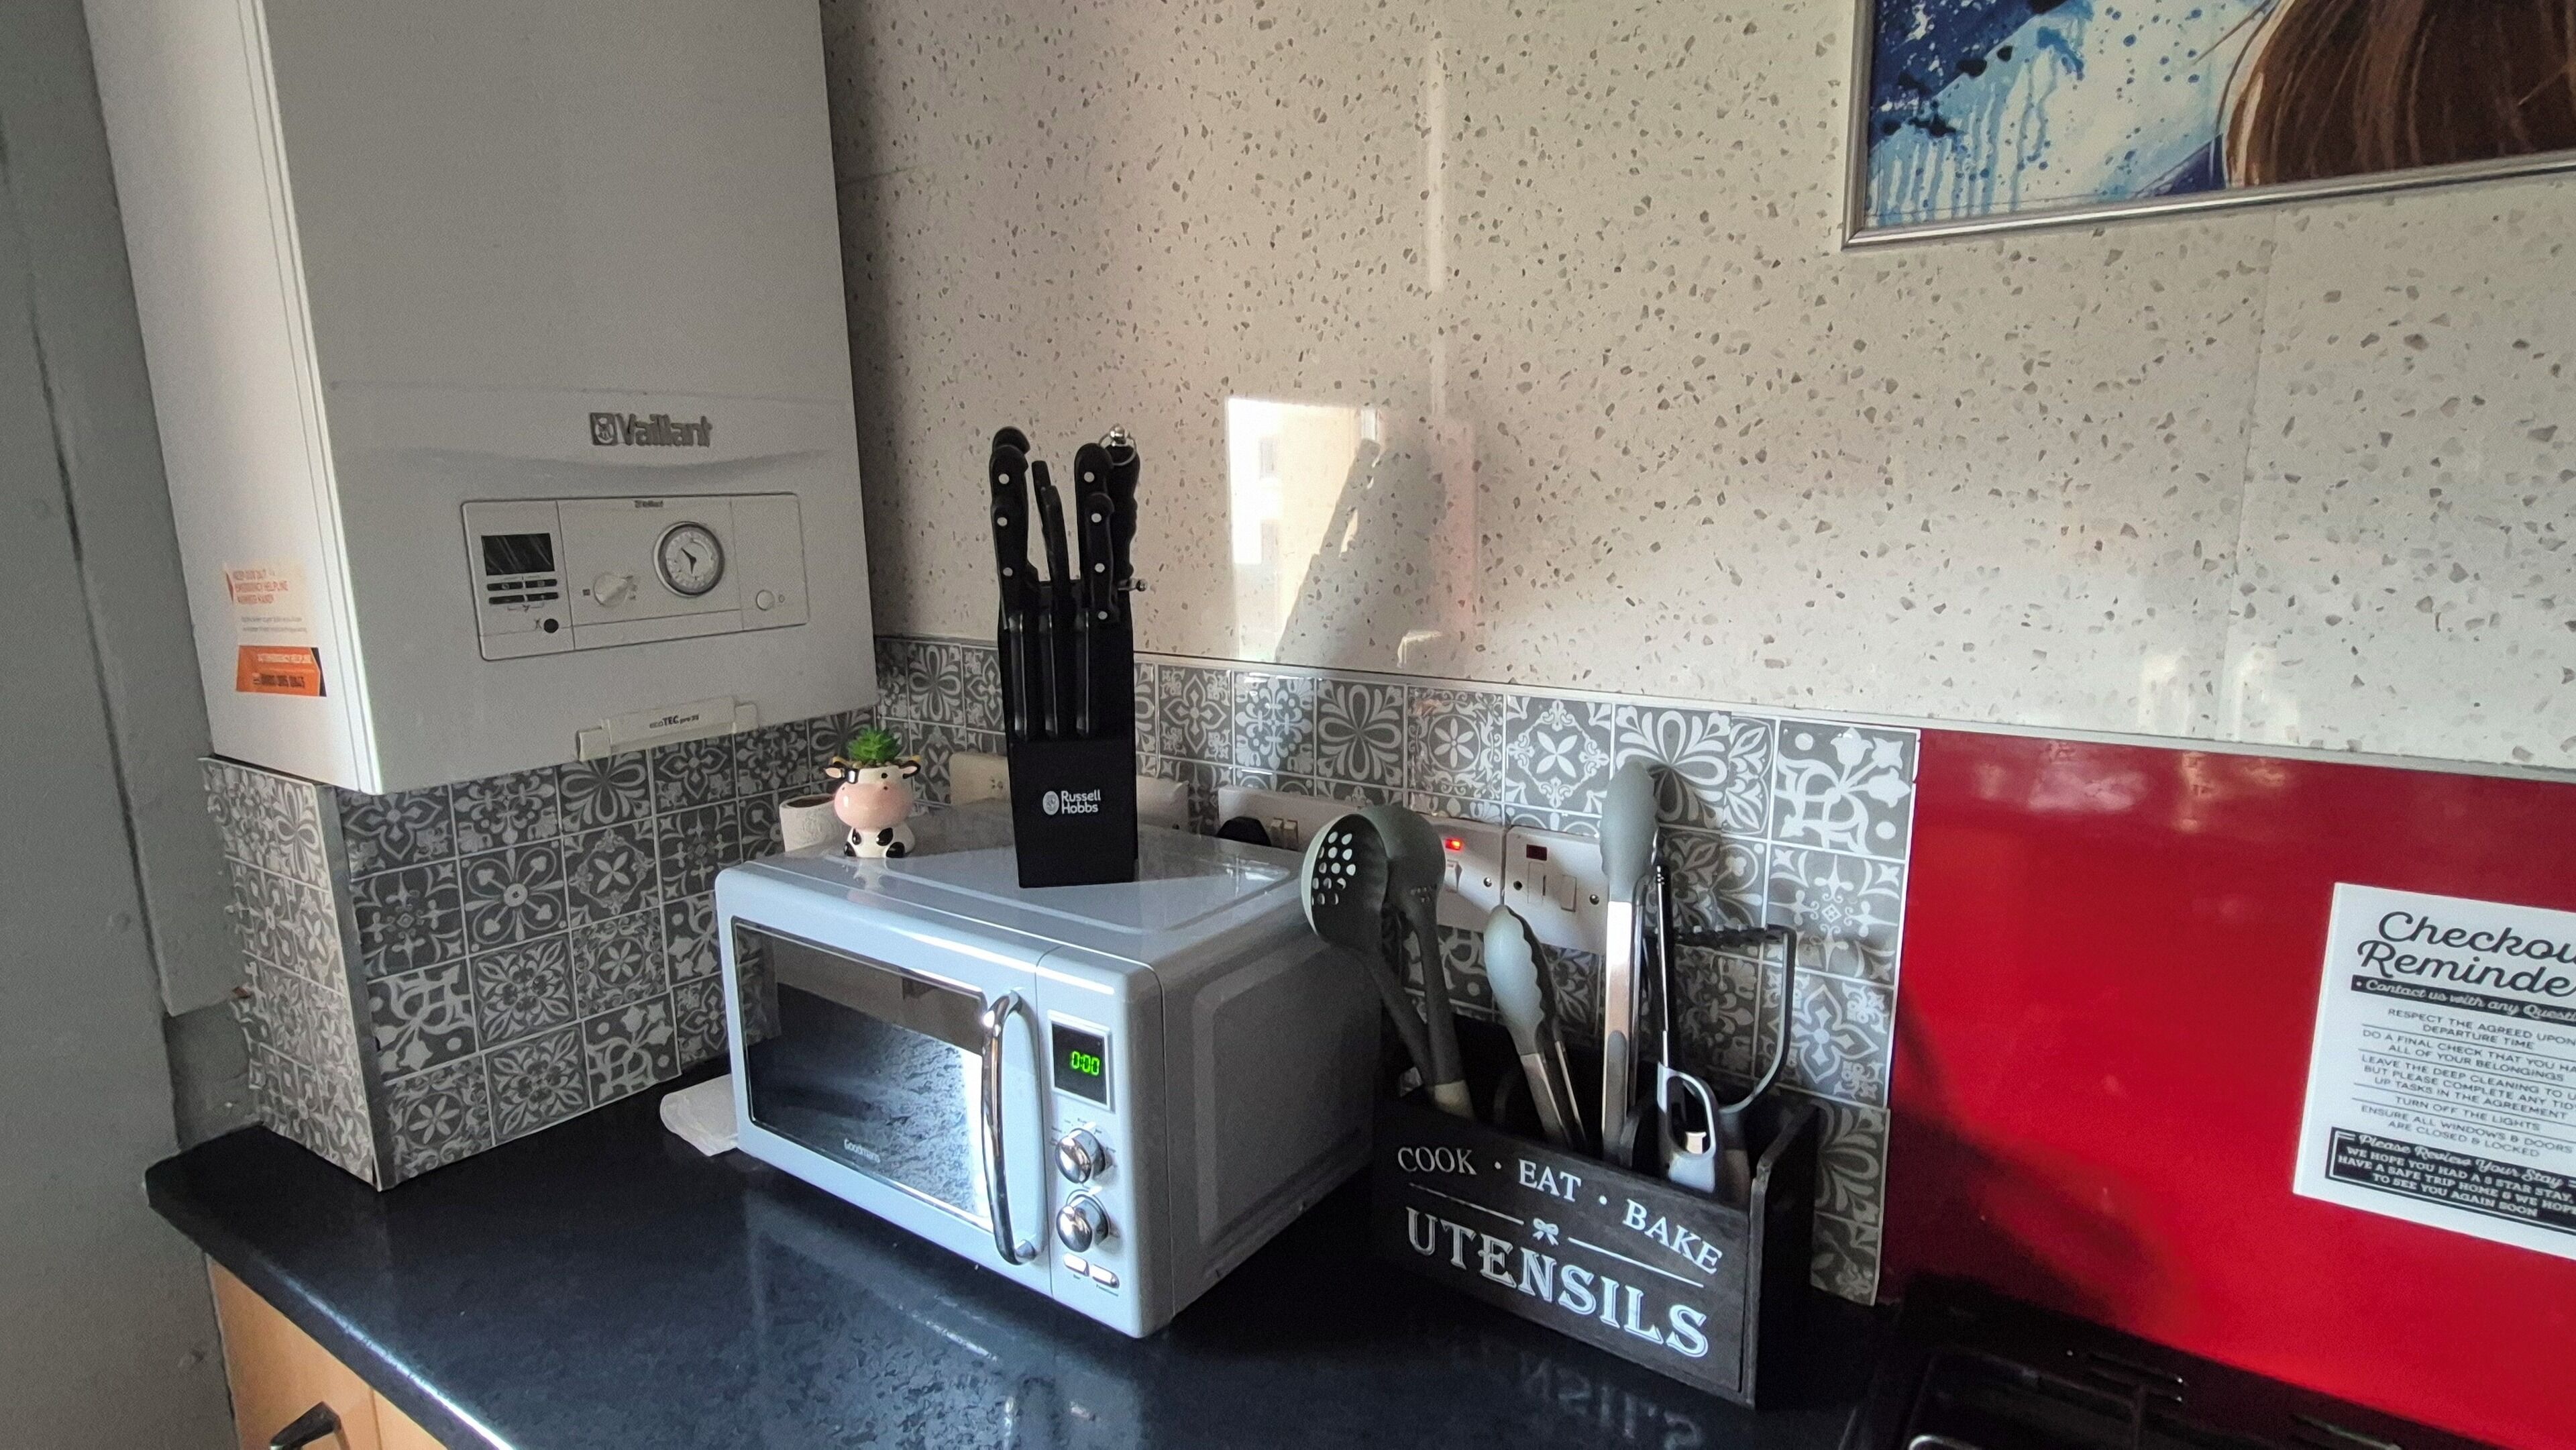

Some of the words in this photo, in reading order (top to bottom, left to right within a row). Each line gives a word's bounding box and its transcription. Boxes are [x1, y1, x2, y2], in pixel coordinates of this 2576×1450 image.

[615, 413, 713, 448] Vaillant
[1061, 789, 1102, 802] Russell
[1061, 800, 1098, 815] Hobbs
[2379, 911, 2576, 964] Checkou
[2357, 940, 2576, 997] Reminde
[2366, 980, 2426, 998] Contact
[2428, 992, 2447, 1001] us
[2450, 994, 2485, 1007] with
[2487, 1001, 2520, 1015] any
[2388, 1008, 2443, 1023] RESPECT
[2449, 1018, 2473, 1029] THE
[2478, 1023, 2532, 1039] AGREED
[2536, 1033, 2576, 1047] UPON
[2423, 1025, 2498, 1043] DEPARTURE
[2504, 1037, 2534, 1049] TIME
[1071, 1051, 1100, 1076] 0:00
[2363, 1029, 2381, 1039] DO
[2398, 1035, 2432, 1048] FINAL
[2437, 1043, 2482, 1056] CHECK
[2488, 1051, 2522, 1063] THAT
[2527, 1058, 2555, 1070] YOU
[2559, 1064, 2576, 1074] HA
[2389, 1045, 2410, 1055] ALL
[2415, 1049, 2432, 1057] OF
[2437, 1053, 2471, 1065] YOUR
[2475, 1059, 2564, 1082] BELONGINGS
[2362, 1054, 2400, 1068] LEAVE
[2405, 1062, 2429, 1073] THE
[2432, 1068, 2466, 1080] DEEP
[2470, 1075, 2539, 1094] CLEANING
[2545, 1088, 2563, 1098] TO
[2567, 1092, 2576, 1101] U
[2364, 1065, 2388, 1075] BUT
[2392, 1070, 2438, 1085] PLEASE
[2443, 1080, 2514, 1100] COMPLETE
[2518, 1094, 2546, 1105] ANY
[2375, 1076, 2391, 1085] UP
[2396, 1081, 2432, 1094] TASKS
[2437, 1089, 2449, 1098] IN
[2455, 1092, 2480, 1102] THE
[2483, 1098, 2567, 1119] AGREEMENT
[2361, 1105, 2410, 1121] ENSURE
[2412, 1116, 2436, 1126] ALL
[2440, 1121, 2506, 1140] WINDOWS
[2524, 1138, 2573, 1153] DOORS
[2396, 1096, 2429, 1108] TURN
[2432, 1104, 2458, 1114] OFF
[2463, 1109, 2487, 1121] THE
[2492, 1116, 2540, 1131] LIGHTS
[2388, 1121, 2412, 1131] ARE
[2416, 1126, 2467, 1143] CLOSED
[2485, 1141, 2539, 1157] LOCKED
[2338, 1155, 2373, 1170] HAVE
[2375, 1163, 2385, 1173] A
[2388, 1166, 2421, 1180] SAFE
[2424, 1174, 2456, 1186] TRIP
[2458, 1182, 2499, 1198] HOME
[2514, 1194, 2538, 1206] WE
[2347, 1146, 2367, 1158] WE
[2370, 1151, 2406, 1166] HOPE
[2408, 1159, 2435, 1172] YOU
[2438, 1166, 2468, 1179] HAD
[2471, 1174, 2481, 1183] A
[2496, 1179, 2532, 1194] STAR
[2359, 1134, 2411, 1153] Please
[2414, 1146, 2472, 1166] Review
[2475, 1158, 2521, 1177] Your
[2521, 1169, 2565, 1189] Stay
[1397, 1147, 1477, 1175] COOK
[1518, 1158, 1581, 1202] EAT
[1622, 1199, 1723, 1274] BAKE
[2373, 1173, 2390, 1184] TO
[2393, 1178, 2417, 1190] SEE
[2420, 1184, 2448, 1196] YOU
[2450, 1191, 2496, 1208] AGAIN
[2498, 1202, 2538, 1217] SOON
[1405, 1206, 1709, 1357] UTENSILS
